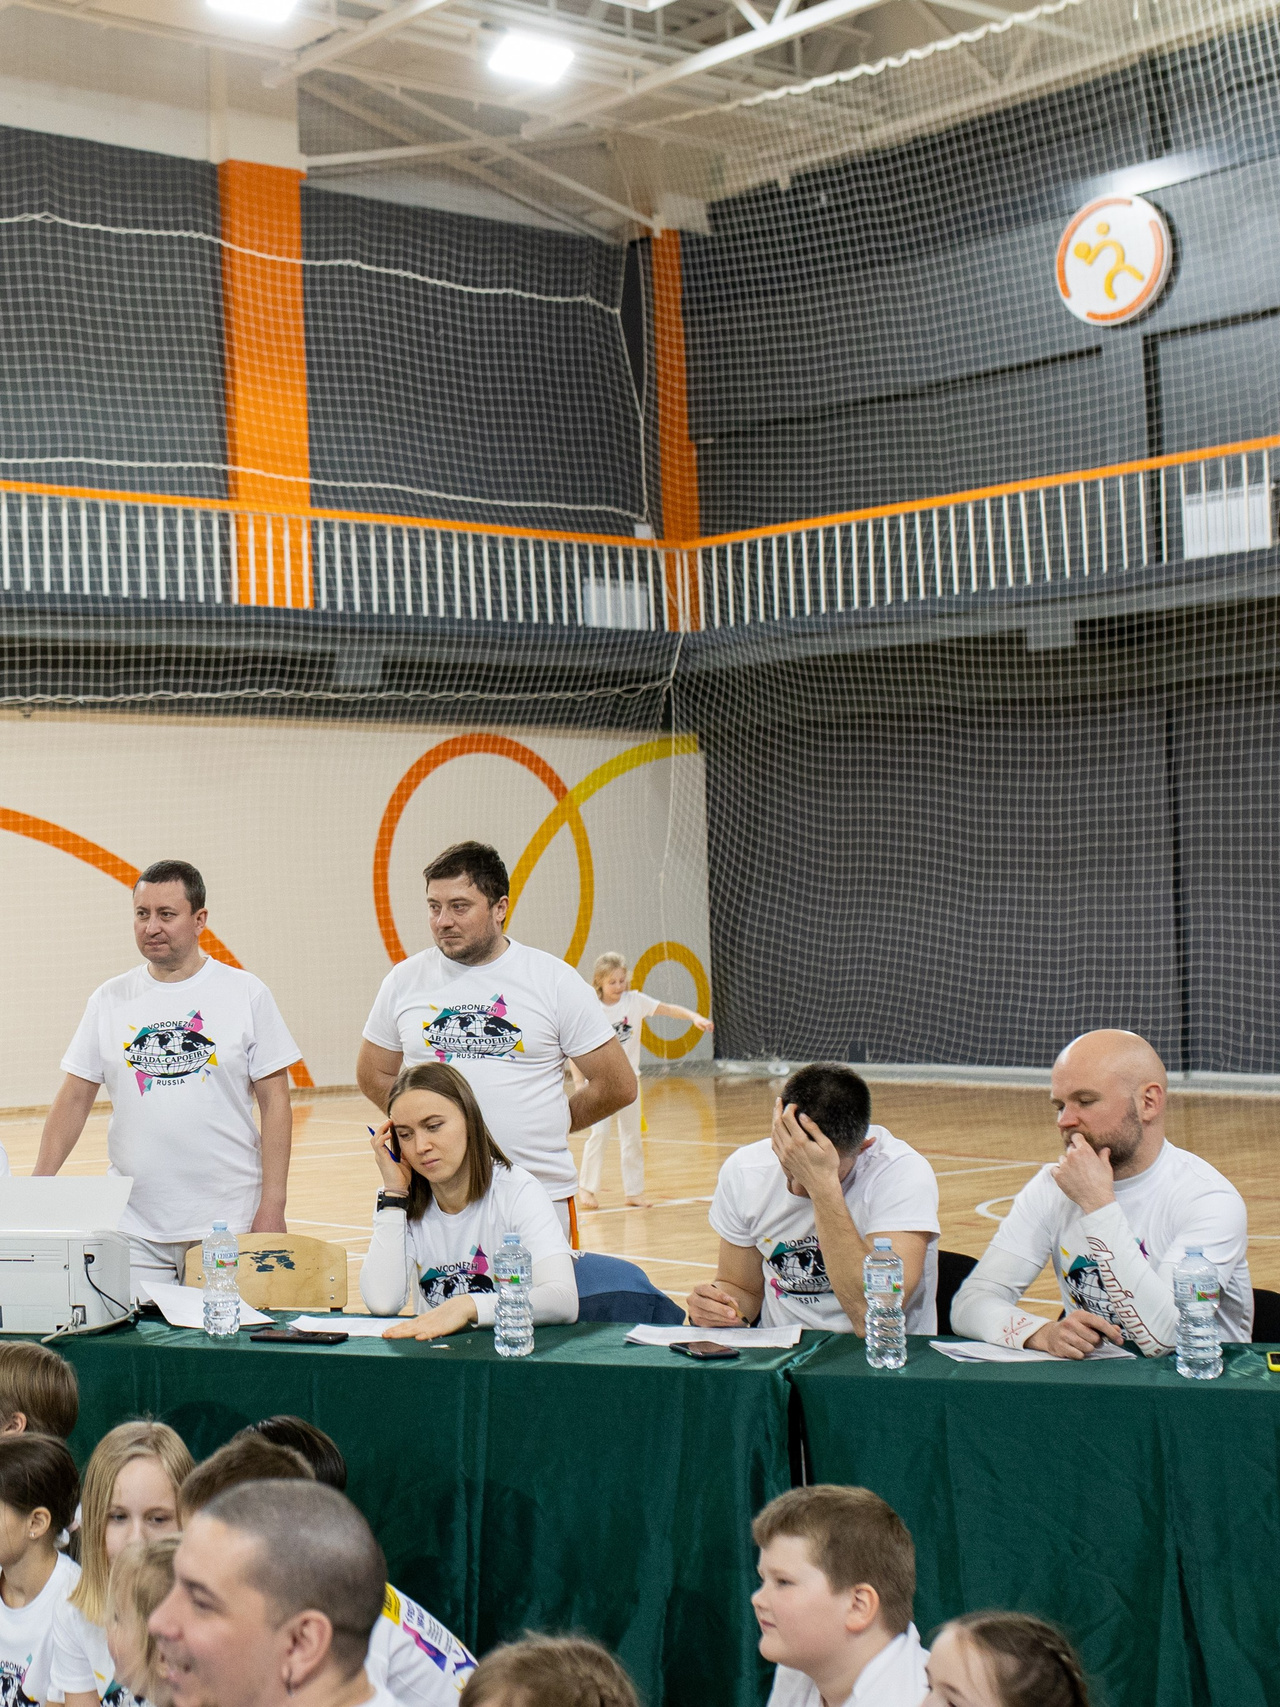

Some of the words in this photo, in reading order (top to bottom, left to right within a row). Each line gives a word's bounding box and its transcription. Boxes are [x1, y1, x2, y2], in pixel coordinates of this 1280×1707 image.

[449, 1003, 498, 1013] VORONEZH
[148, 1020, 194, 1030] VORONEZH
[156, 1078, 186, 1086] RUSSIA
